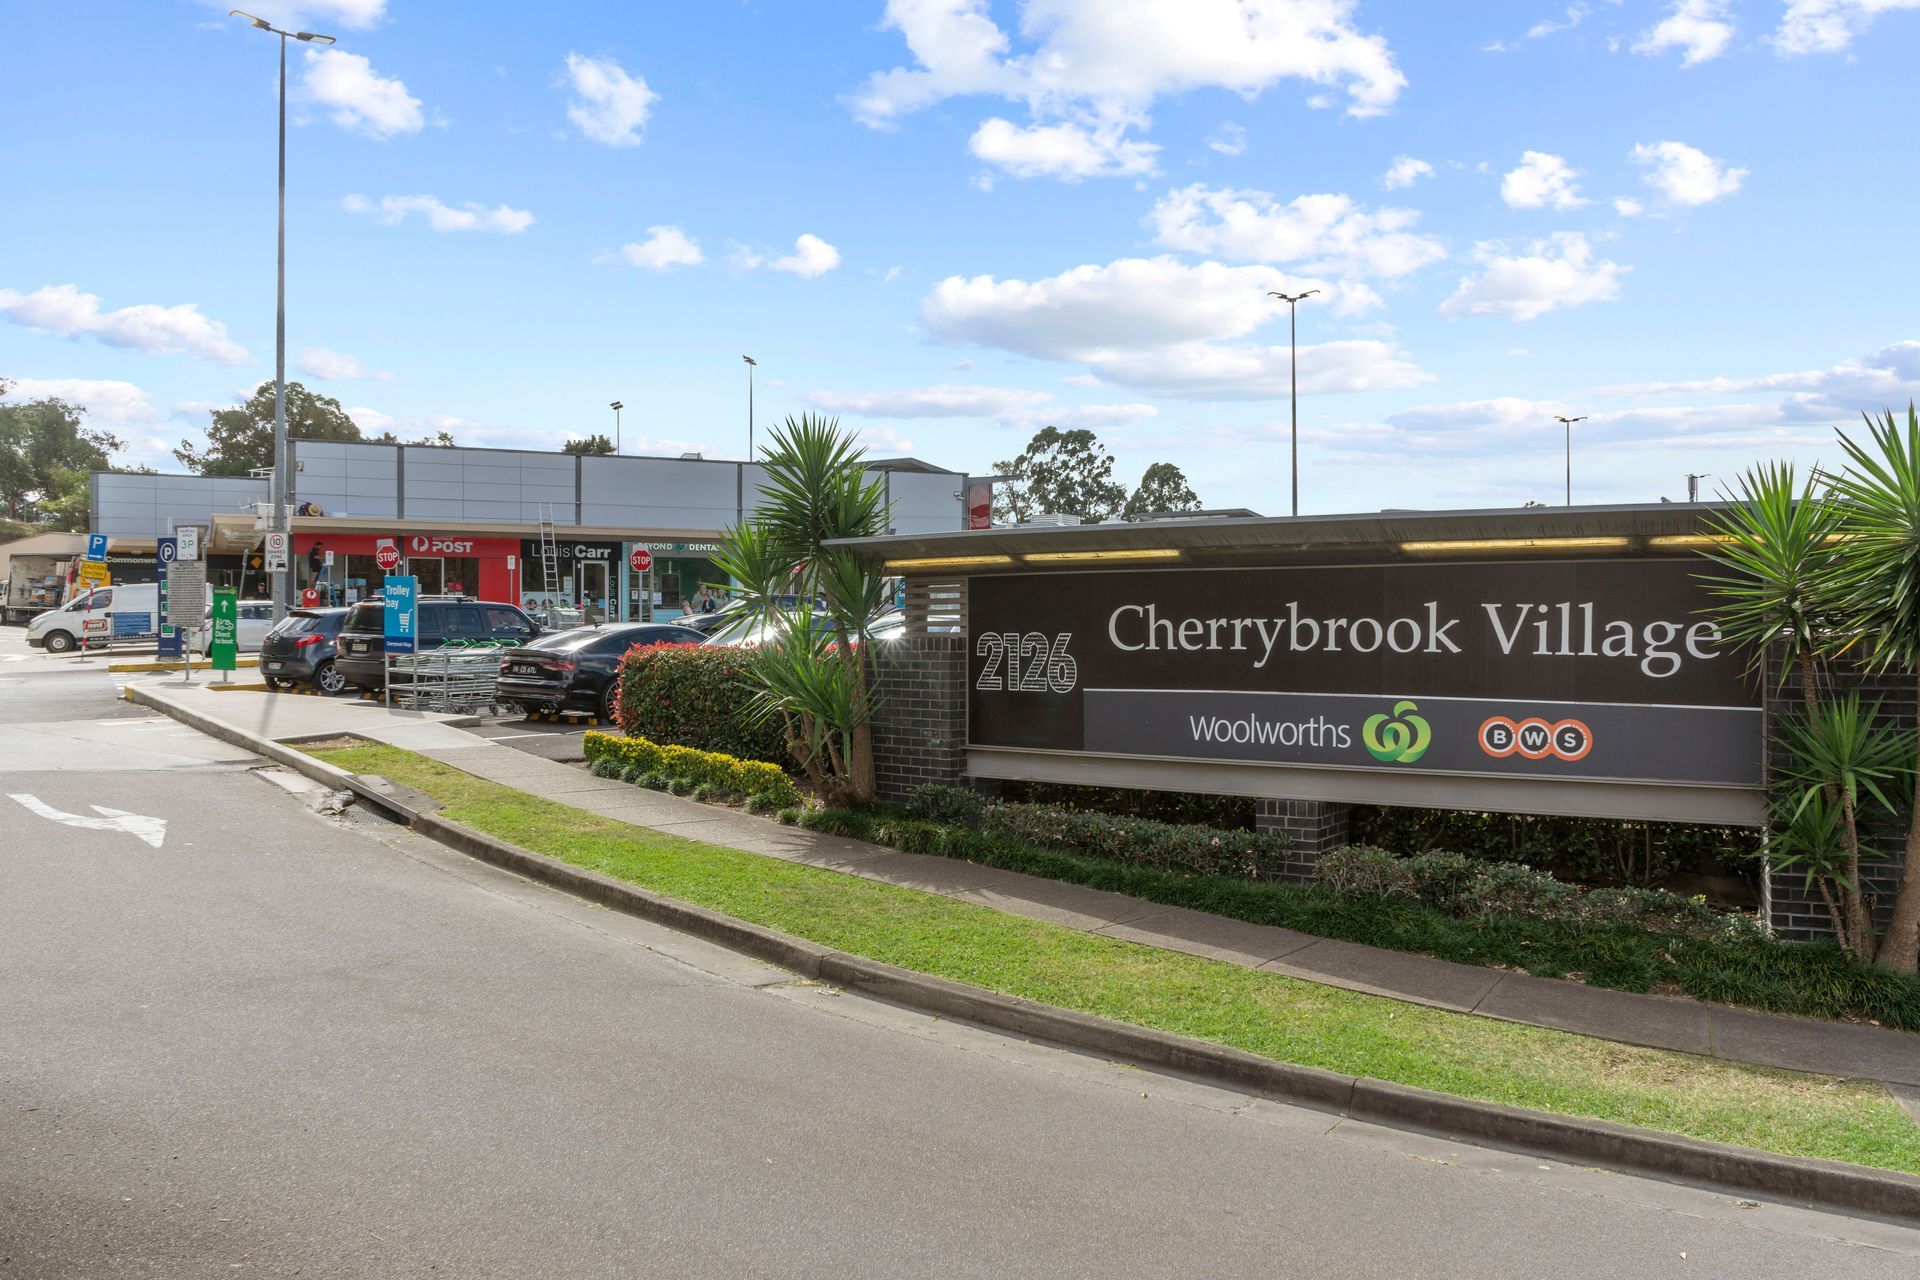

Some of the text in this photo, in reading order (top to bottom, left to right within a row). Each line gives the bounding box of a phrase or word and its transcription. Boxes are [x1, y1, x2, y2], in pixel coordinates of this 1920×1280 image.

[93, 537, 103, 549] P
[181, 540, 194, 549] 3P
[273, 538, 281, 546] 10
[432, 541, 473, 553] POST
[164, 547, 172, 559] P
[378, 552, 398, 563] STOP
[574, 545, 611, 558] Carr
[632, 556, 651, 565] STOP
[386, 585, 410, 597] Trolley
[385, 598, 399, 609] bay
[1108, 601, 1722, 678] Cherrybrook Village
[976, 632, 1077, 693] 2126
[1190, 713, 1352, 748] Woolworths
